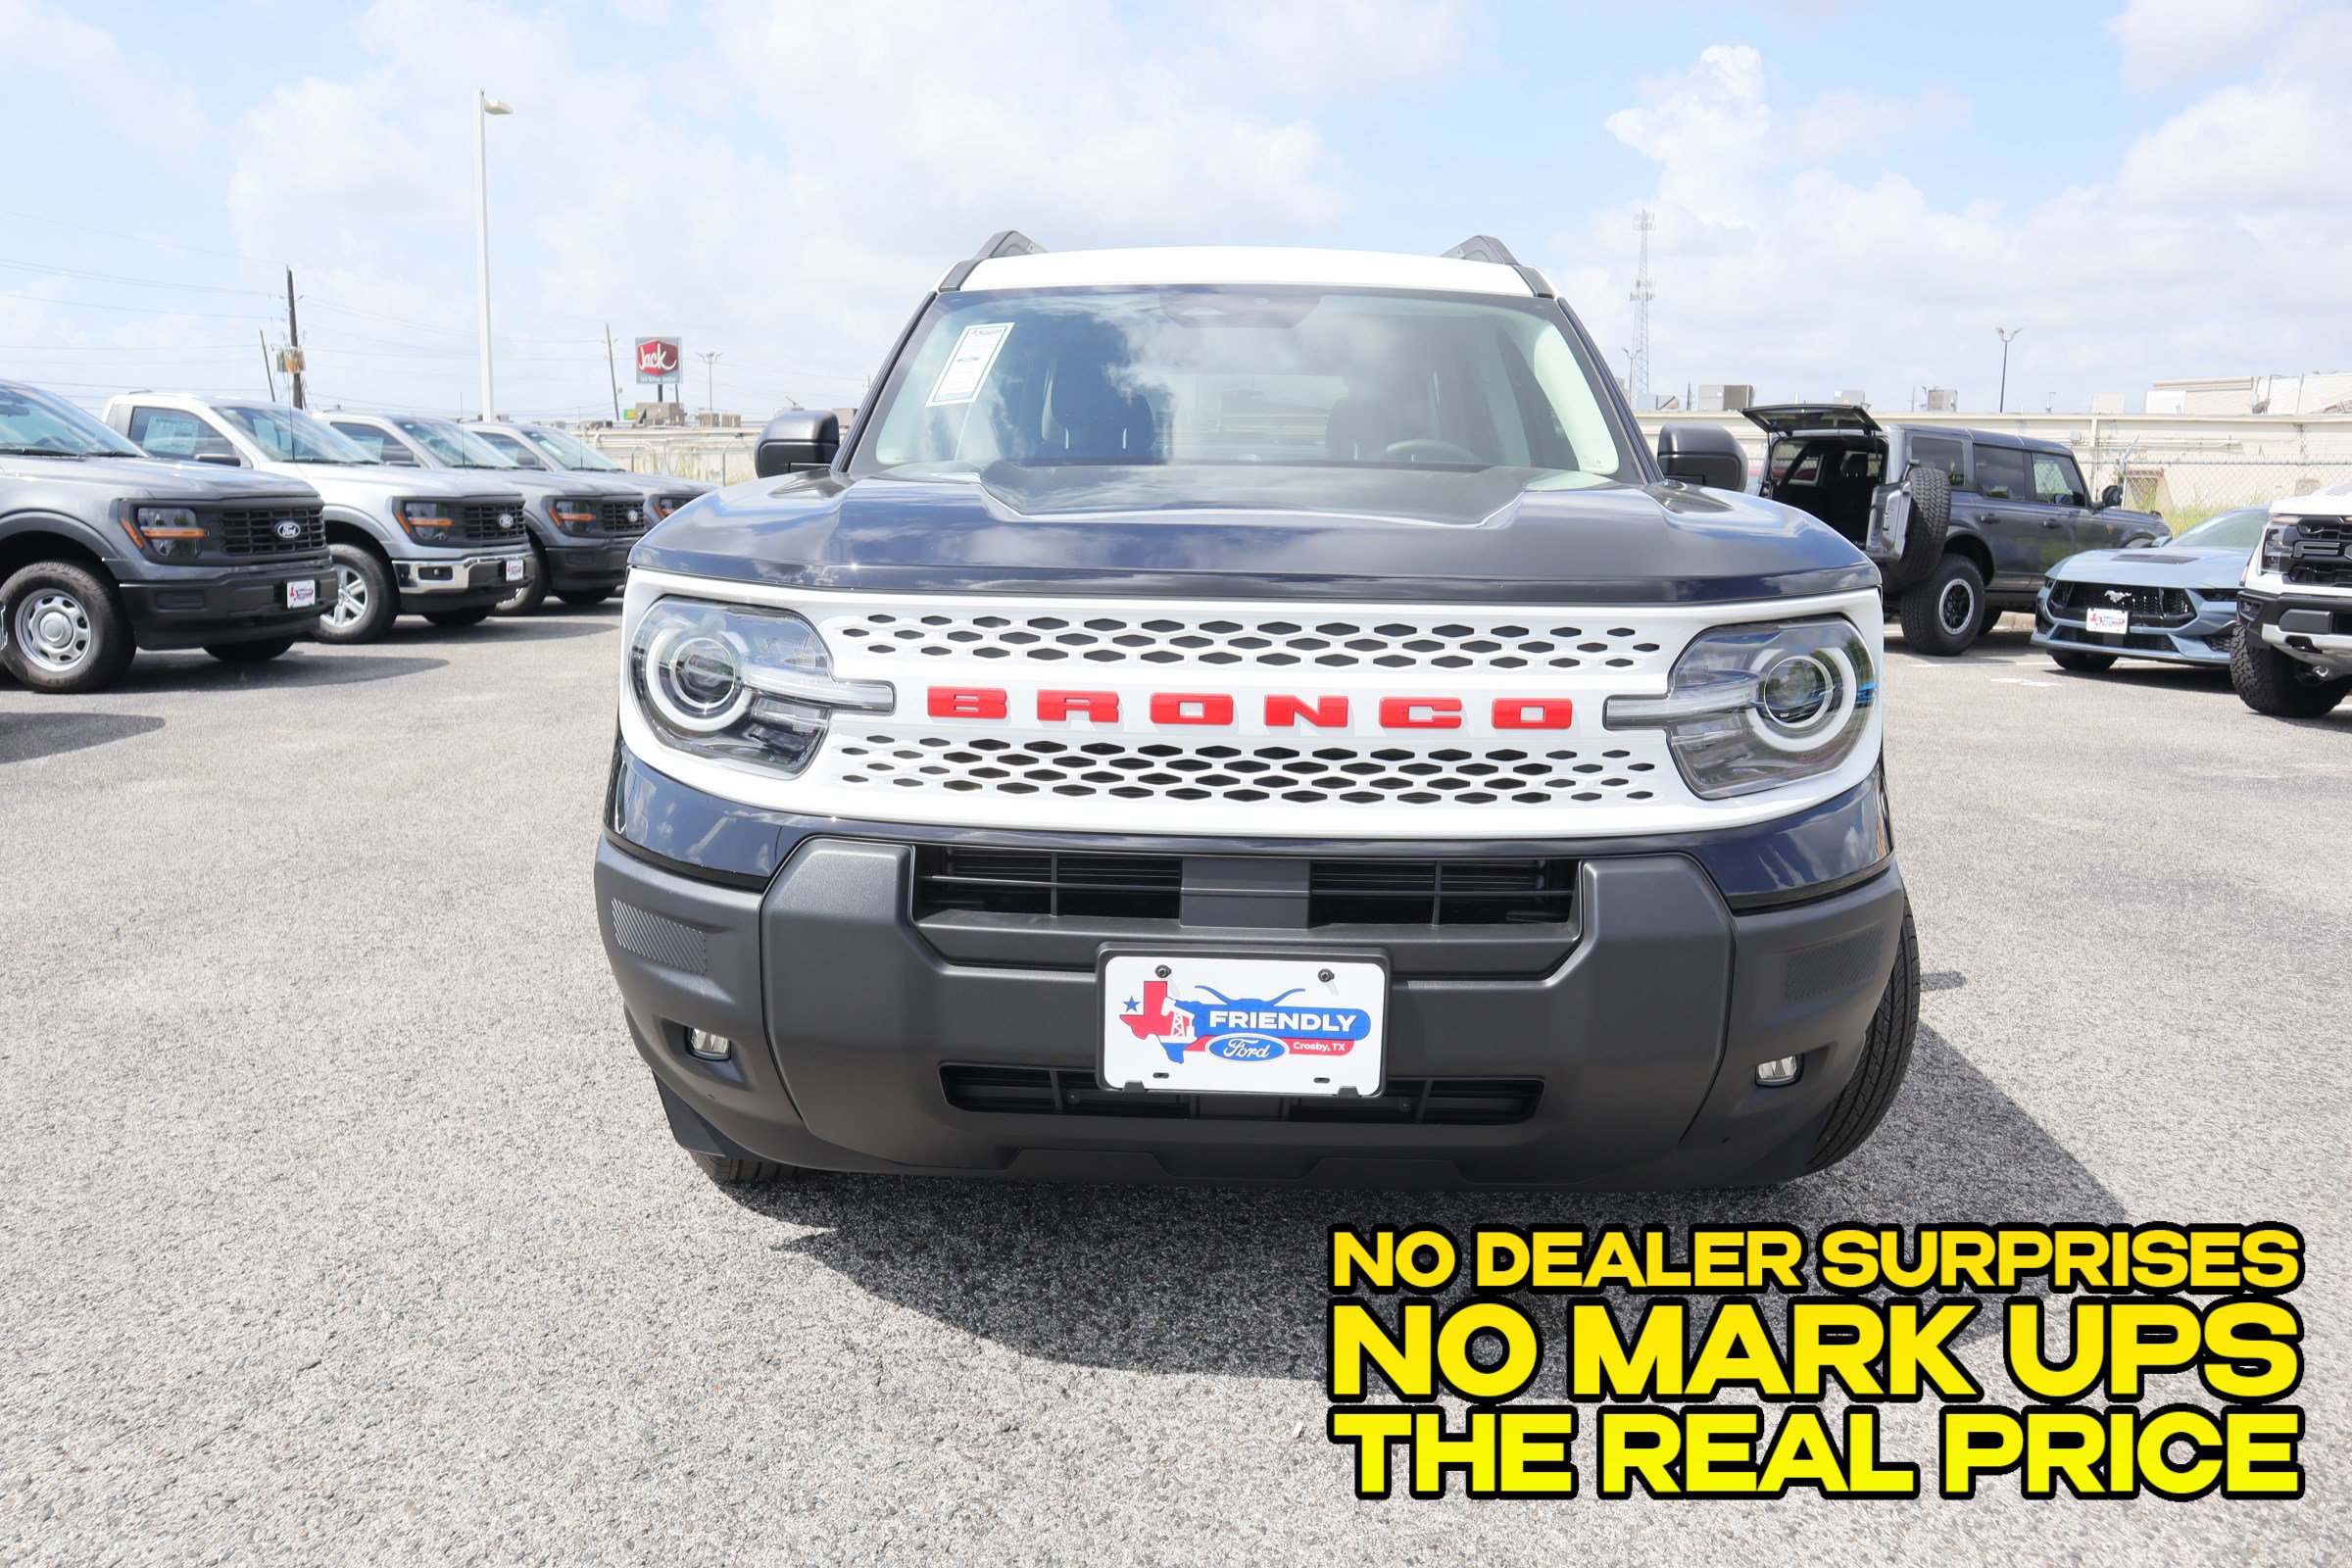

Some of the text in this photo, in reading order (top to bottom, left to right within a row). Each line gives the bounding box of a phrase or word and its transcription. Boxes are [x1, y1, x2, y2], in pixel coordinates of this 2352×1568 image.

[638, 343, 676, 370] Jack
[928, 687, 1573, 729] BRONCO
[1209, 1010, 1357, 1032] FRIENDLY
[1223, 1038, 1270, 1058] Ford
[1293, 1041, 1346, 1052] Crosby, TX
